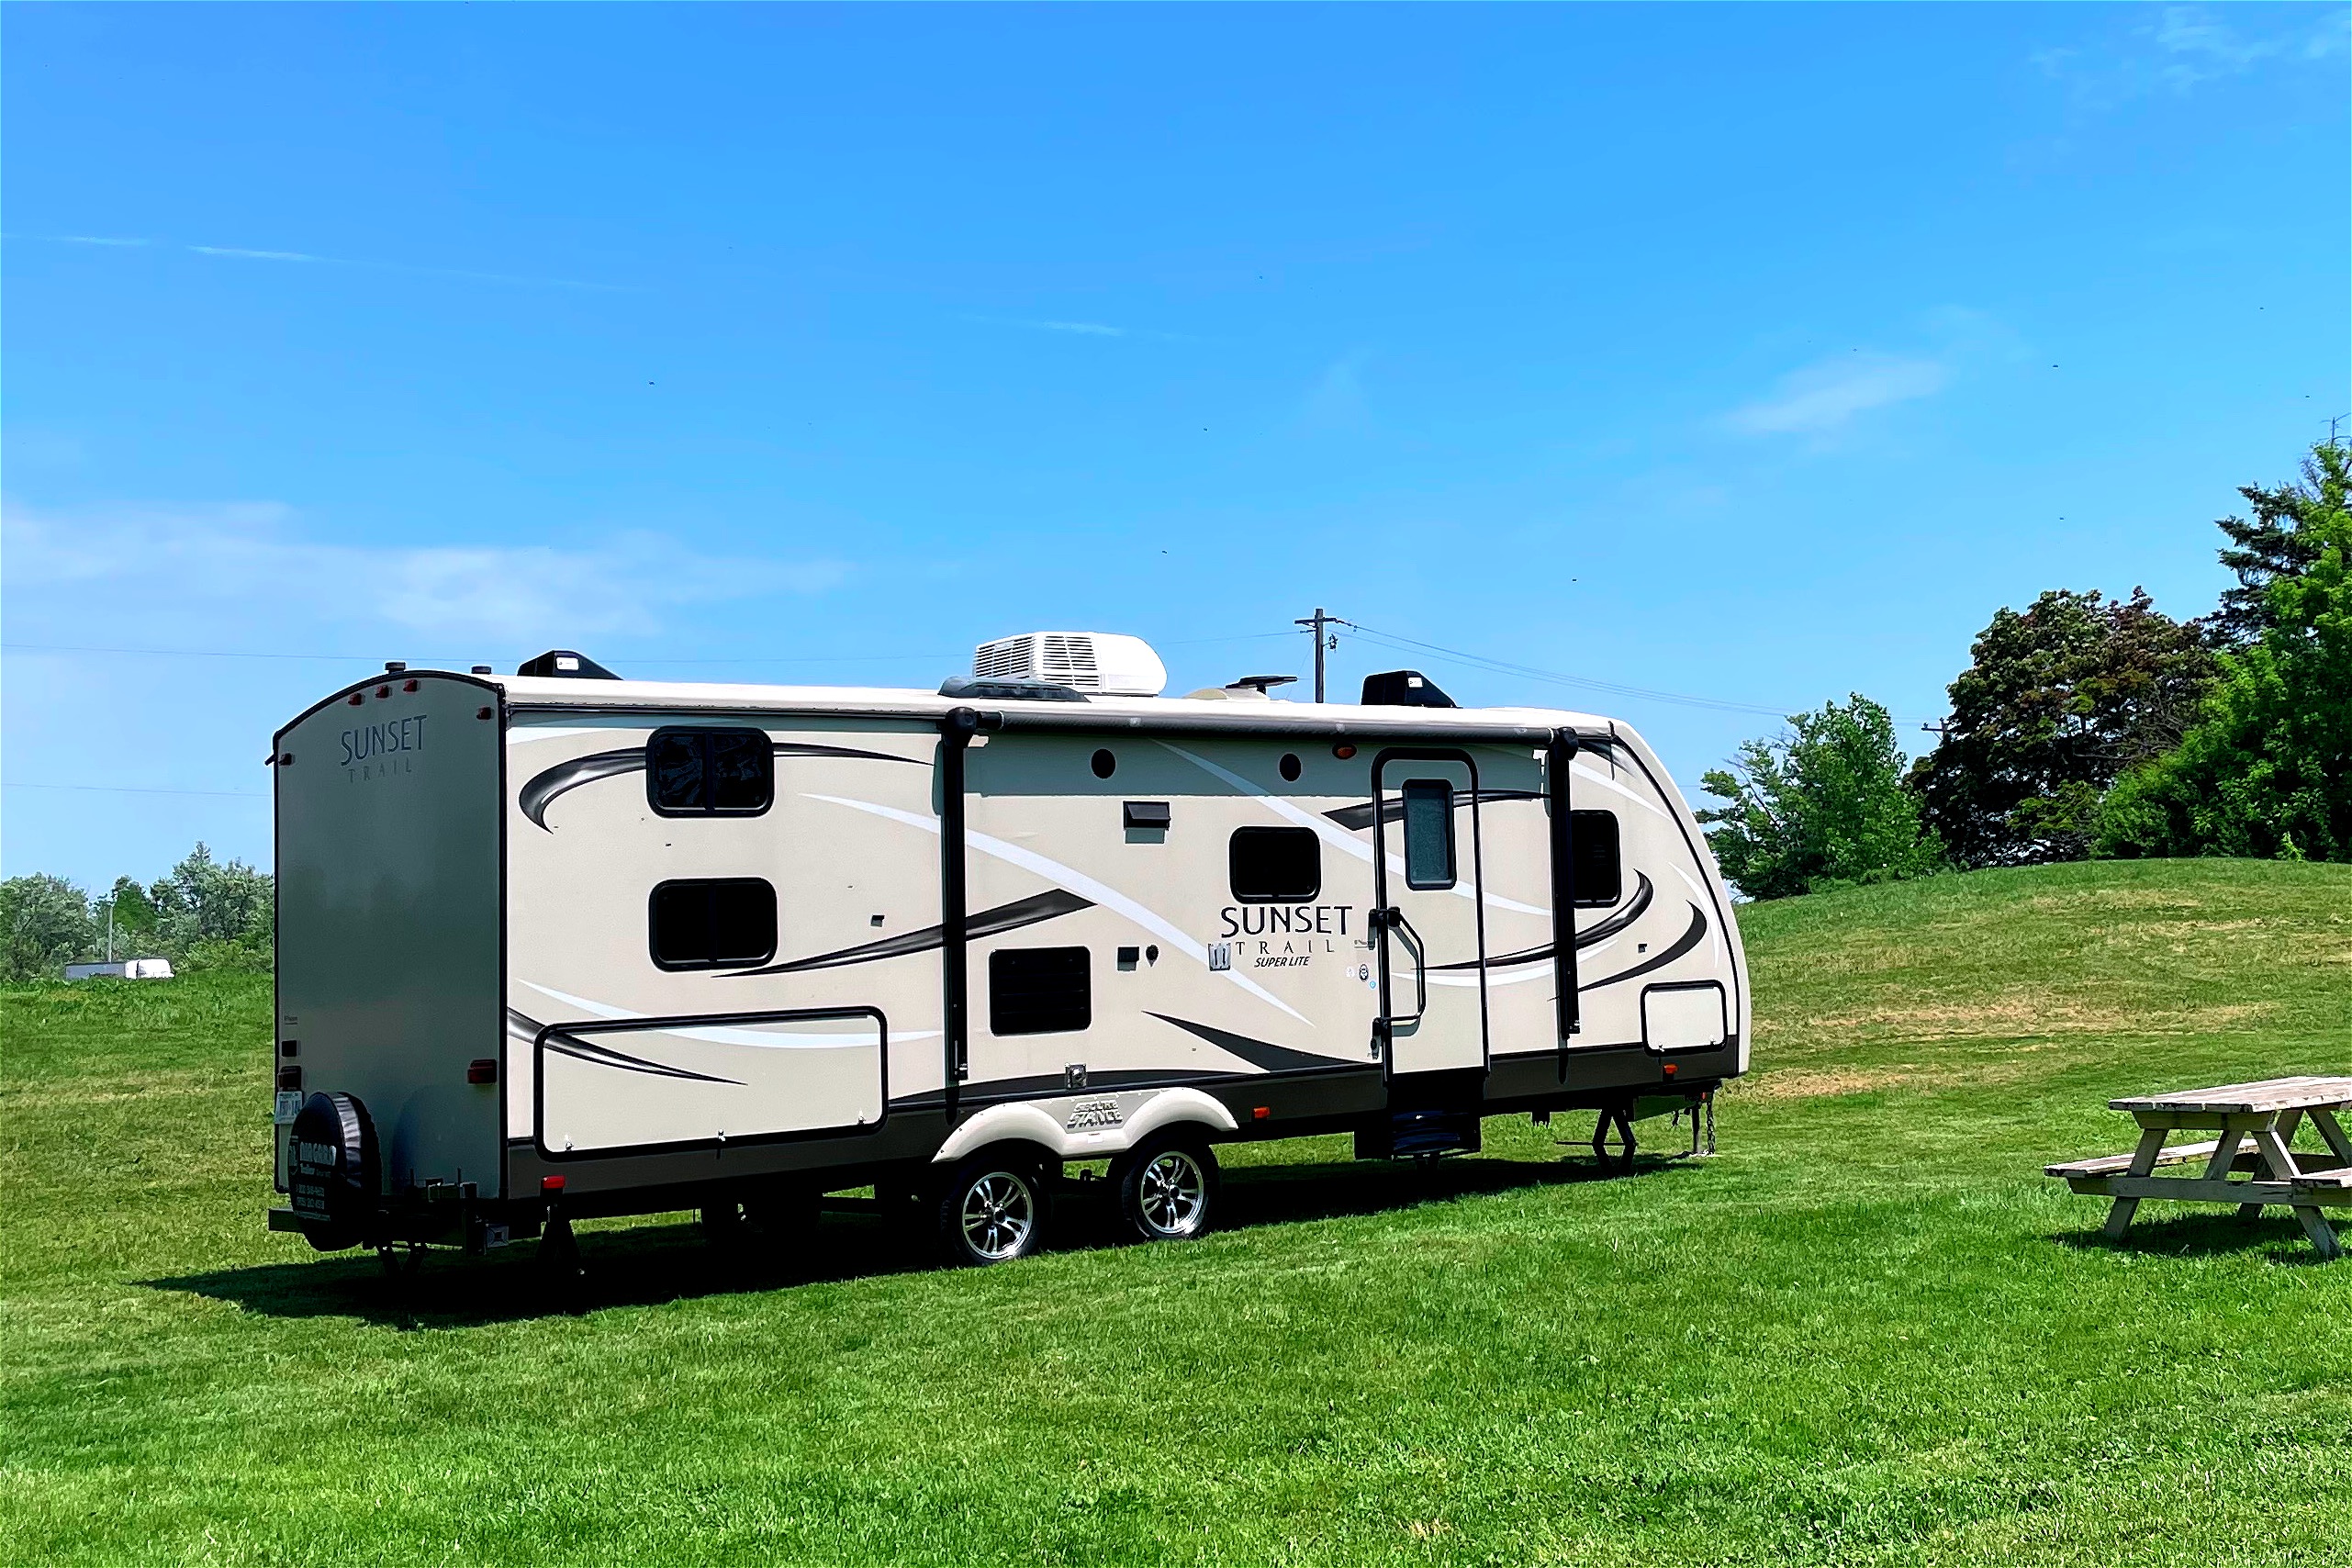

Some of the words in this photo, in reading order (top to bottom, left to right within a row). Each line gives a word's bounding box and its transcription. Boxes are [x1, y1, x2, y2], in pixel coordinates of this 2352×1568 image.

[341, 714, 427, 767] SUNSET
[349, 756, 412, 783] TRAIL
[1220, 905, 1353, 938] SUNSET
[1236, 939, 1335, 956] TRAIL
[1254, 956, 1287, 969] SUPER
[1289, 956, 1310, 967] LITE
[1067, 1109, 1124, 1129] STANCE
